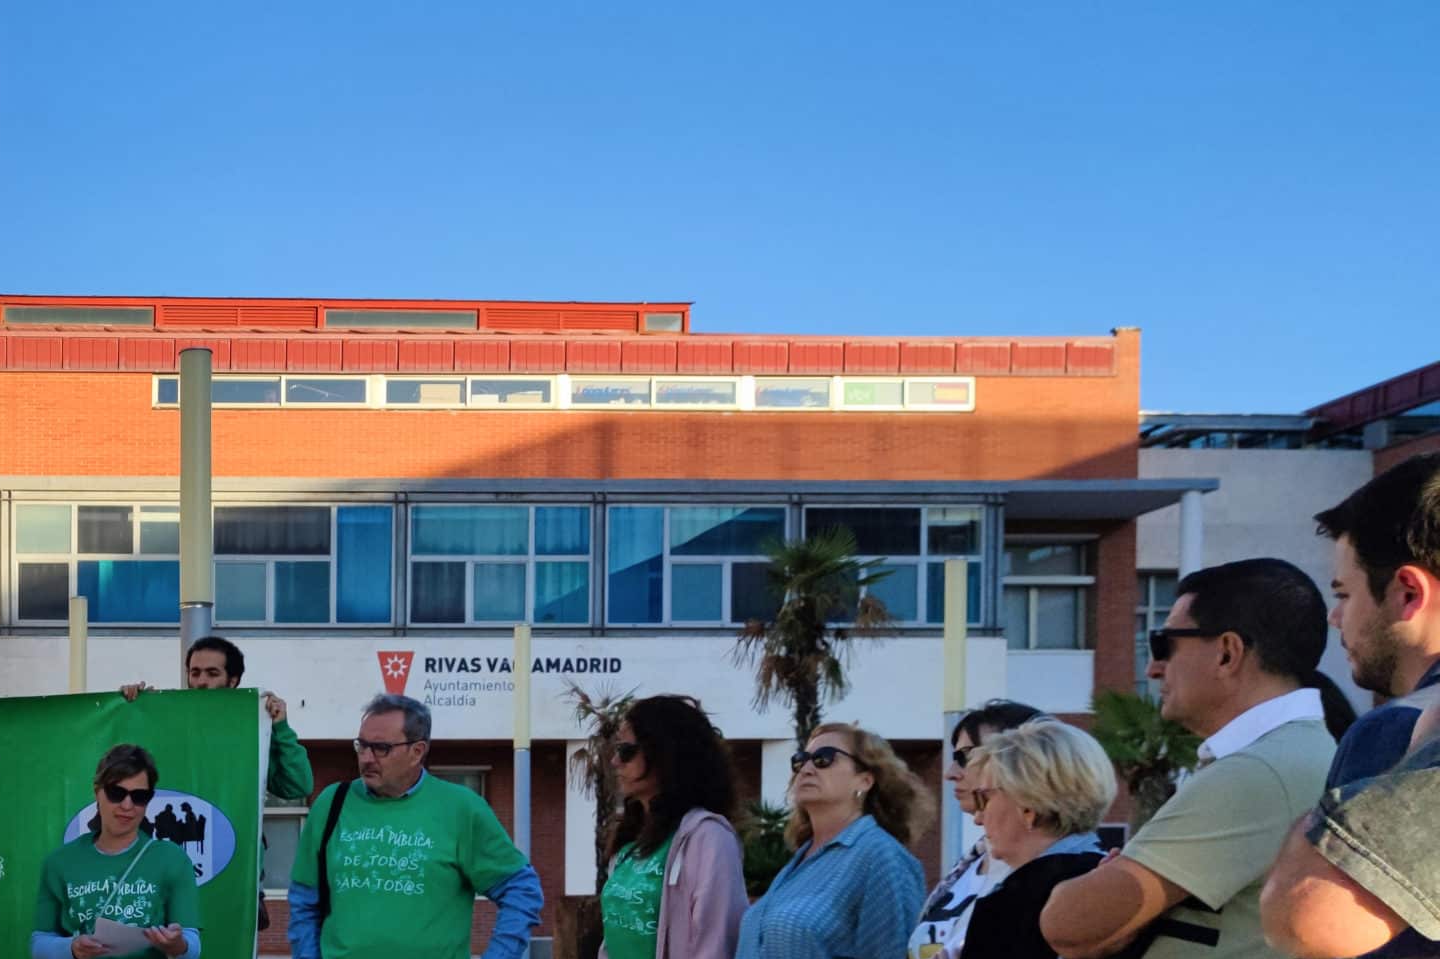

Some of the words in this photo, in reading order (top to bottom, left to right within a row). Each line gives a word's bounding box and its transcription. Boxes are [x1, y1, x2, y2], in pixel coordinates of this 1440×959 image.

[424, 657, 482, 674] RIVAS
[486, 657, 622, 674] VAAMADRID
[423, 679, 515, 694] Ayuntamiento
[424, 693, 477, 707] Alcaldía
[340, 828, 384, 843] ESCUELA
[343, 855, 361, 867] DE
[368, 854, 419, 871] TOD@S
[67, 880, 110, 898] ESCUELA
[375, 878, 425, 896] TOD@S
[78, 908, 94, 923] DE
